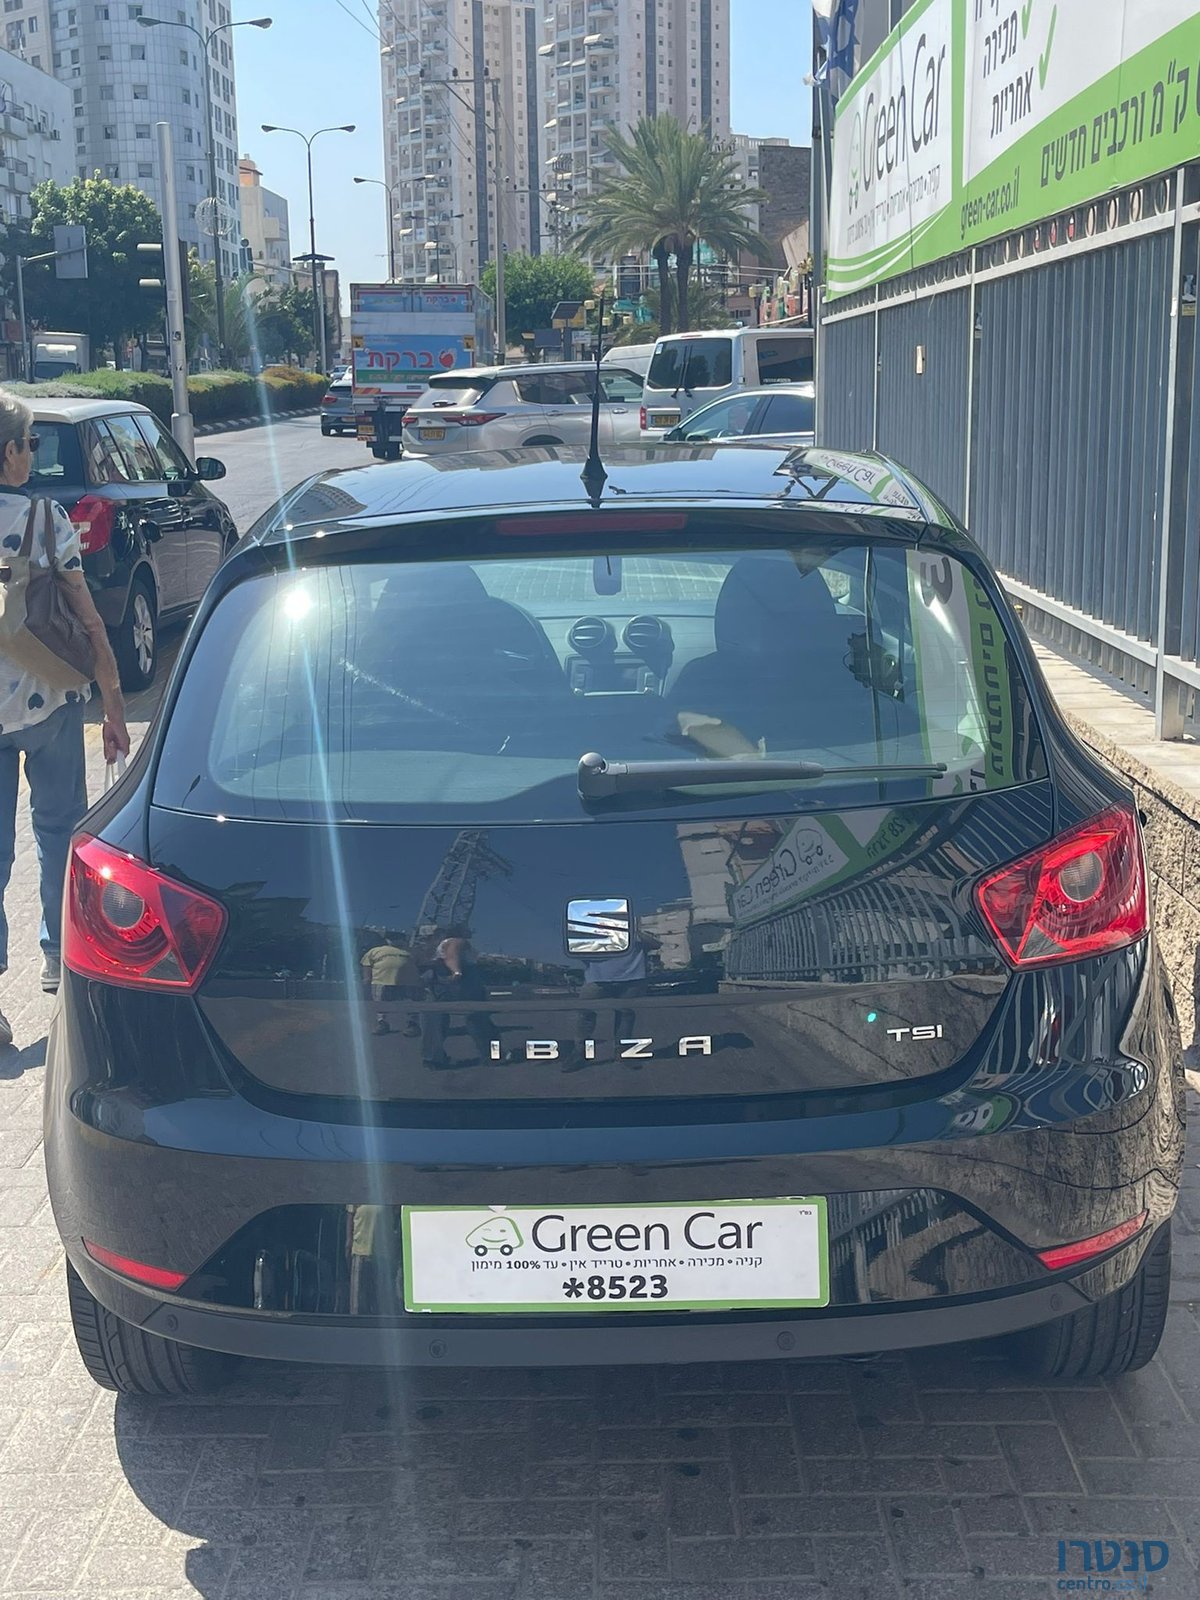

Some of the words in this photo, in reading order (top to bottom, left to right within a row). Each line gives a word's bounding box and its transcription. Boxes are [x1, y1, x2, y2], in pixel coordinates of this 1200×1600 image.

[983, 10, 1018, 79] מכירה
[863, 85, 907, 192] Green
[911, 33, 946, 153] Car
[990, 66, 1034, 139] אחריות
[1091, 90, 1146, 164] ורכבים
[1040, 124, 1087, 188] חדשים
[961, 165, 1020, 240] green-car.co.il
[367, 351, 434, 373] ברקת
[886, 1024, 943, 1042] TSI
[490, 1035, 712, 1060] IBIZA
[531, 1214, 670, 1253] Green
[684, 1211, 763, 1250] Car
[471, 1260, 502, 1272] מימון
[507, 1260, 541, 1270] 100%
[543, 1259, 558, 1269] עד
[569, 1259, 587, 1271] אין
[590, 1259, 623, 1269] טרייד
[633, 1258, 677, 1268] אחריות
[688, 1256, 724, 1267] מכירה
[735, 1256, 763, 1268] קניה
